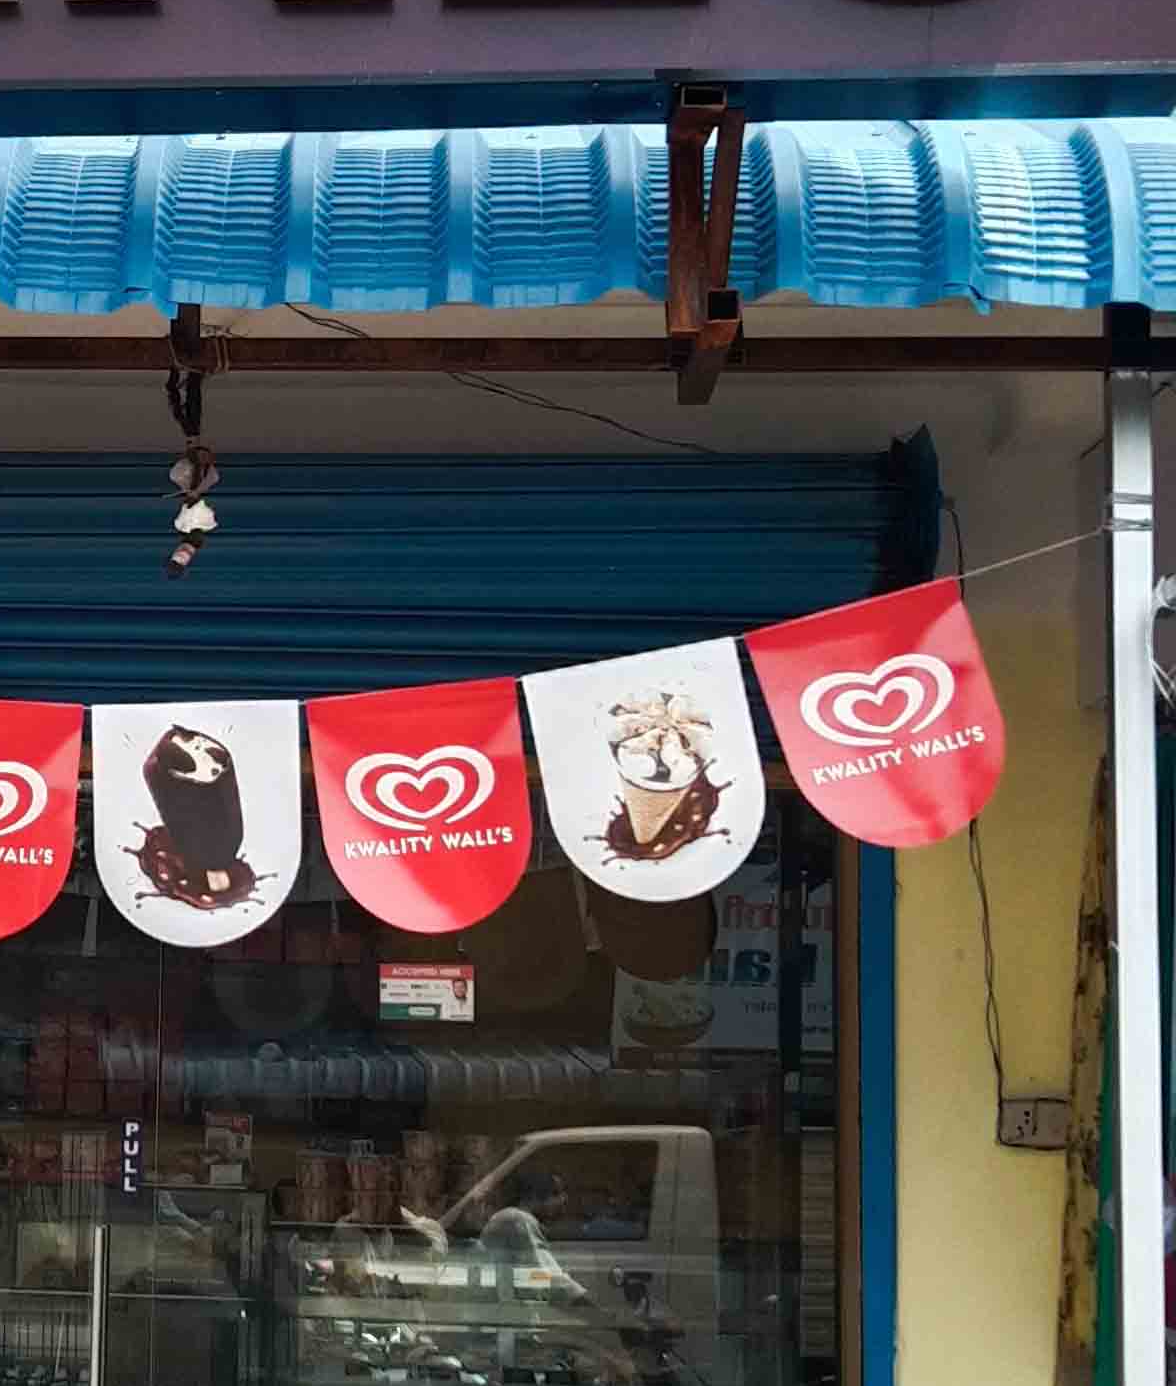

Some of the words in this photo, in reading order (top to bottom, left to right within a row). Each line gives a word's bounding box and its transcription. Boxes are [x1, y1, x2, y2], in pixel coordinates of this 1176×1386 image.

[811, 747, 903, 786] KWALITY
[909, 725, 985, 759] WALL'S
[344, 835, 433, 860] KWALITY
[440, 826, 514, 851] WALL'S
[123, 1121, 140, 1192] PULL
